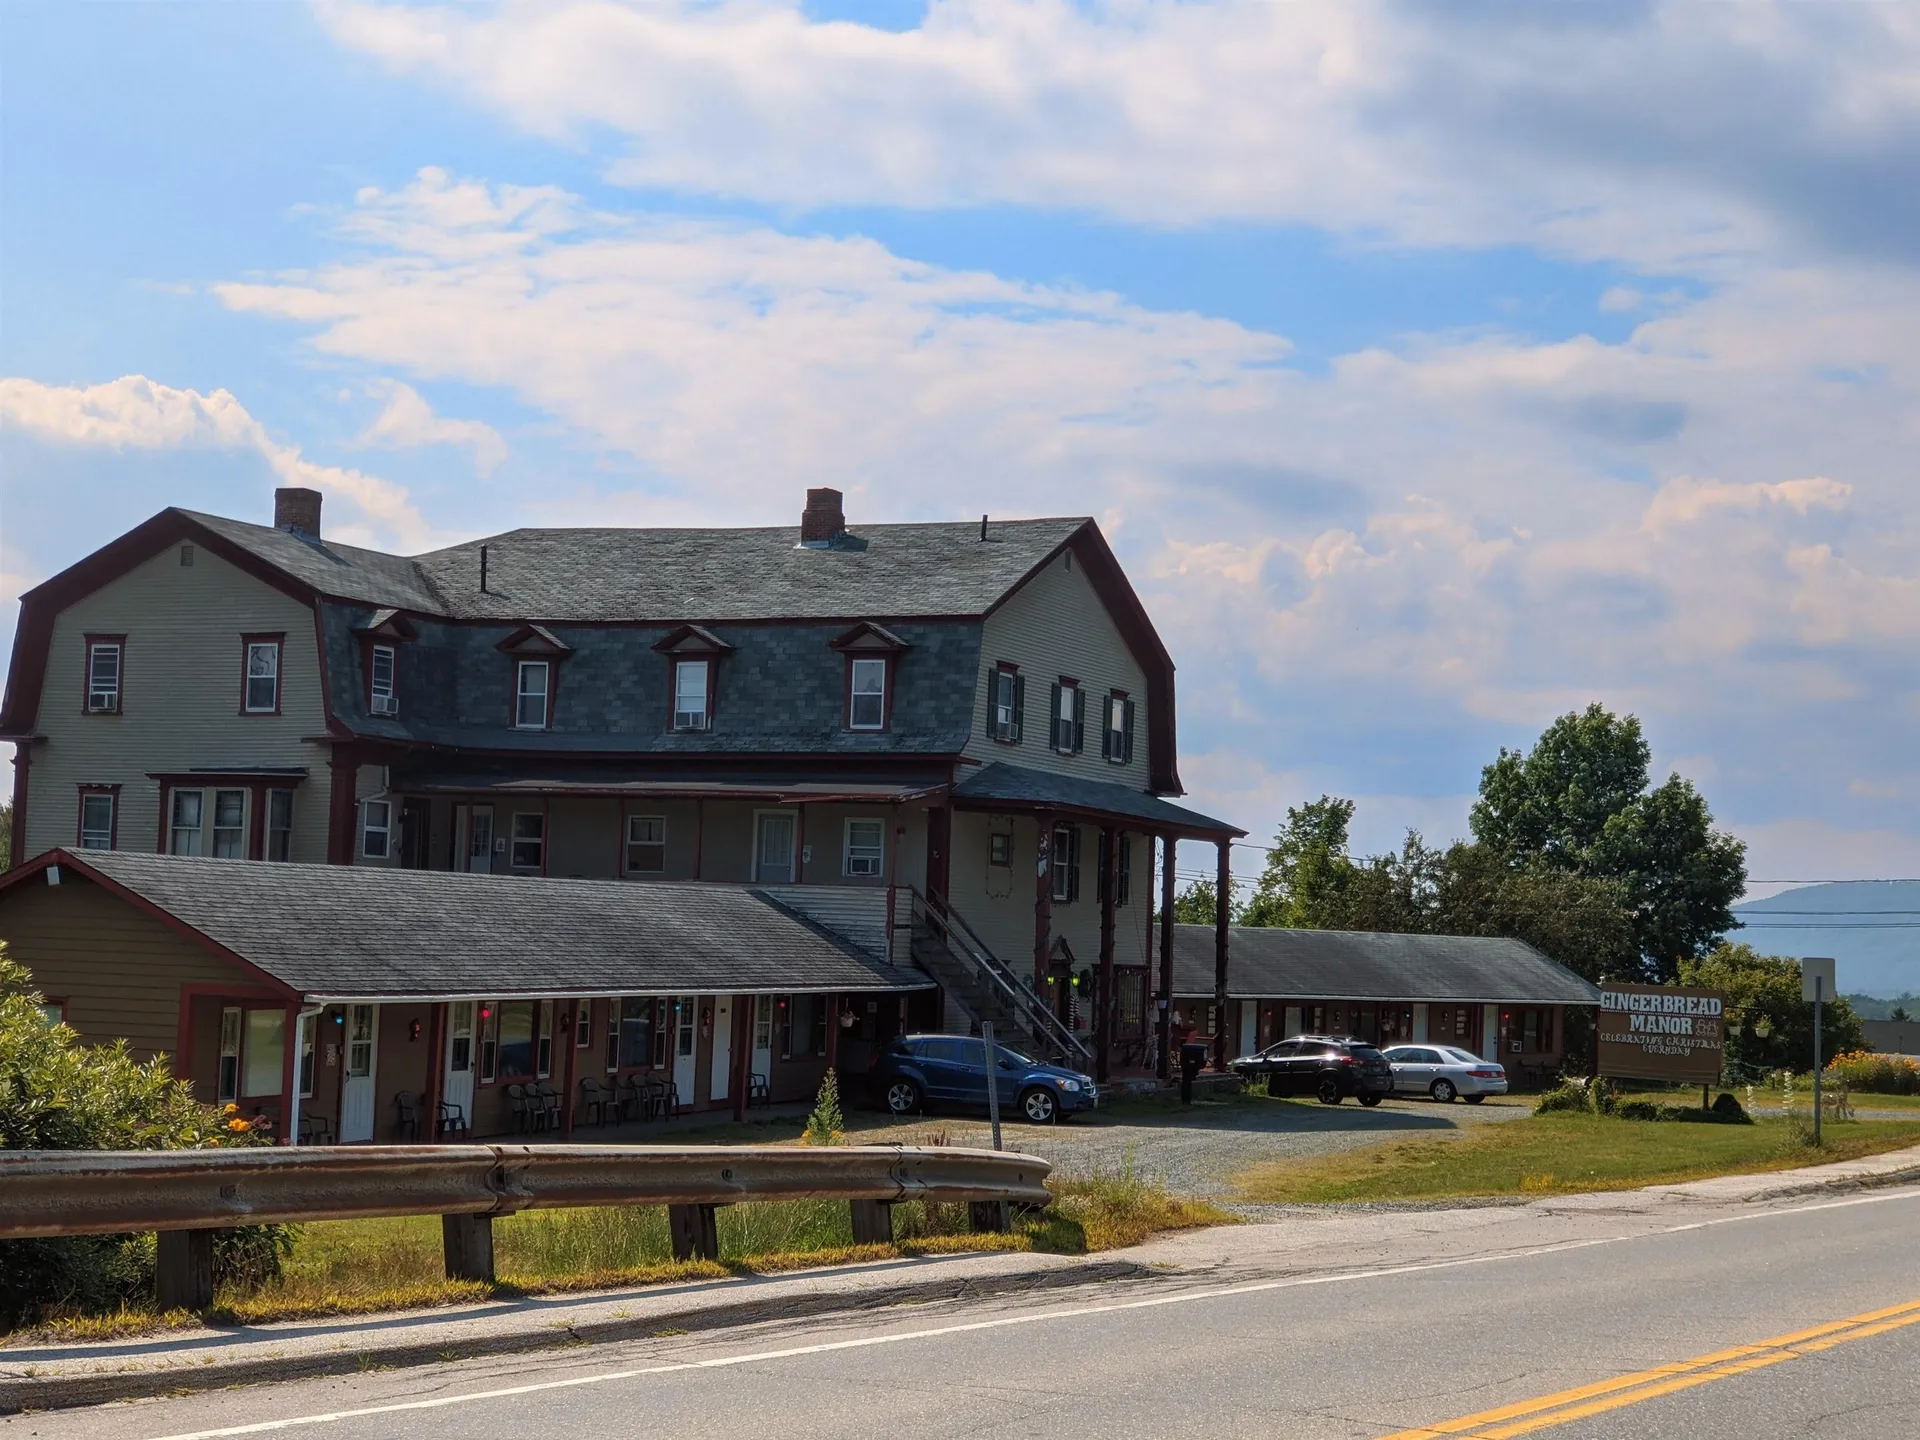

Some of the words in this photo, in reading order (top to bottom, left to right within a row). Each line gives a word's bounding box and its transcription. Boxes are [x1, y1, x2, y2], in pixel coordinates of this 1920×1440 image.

[1600, 991, 1722, 1016] GINGERBREAD
[1630, 1014, 1693, 1035] MANOR
[1600, 1033, 1664, 1046] CELEBRATING
[1666, 1036, 1721, 1050] CHRISTMAS
[1643, 1044, 1691, 1056] EVERYDAY
